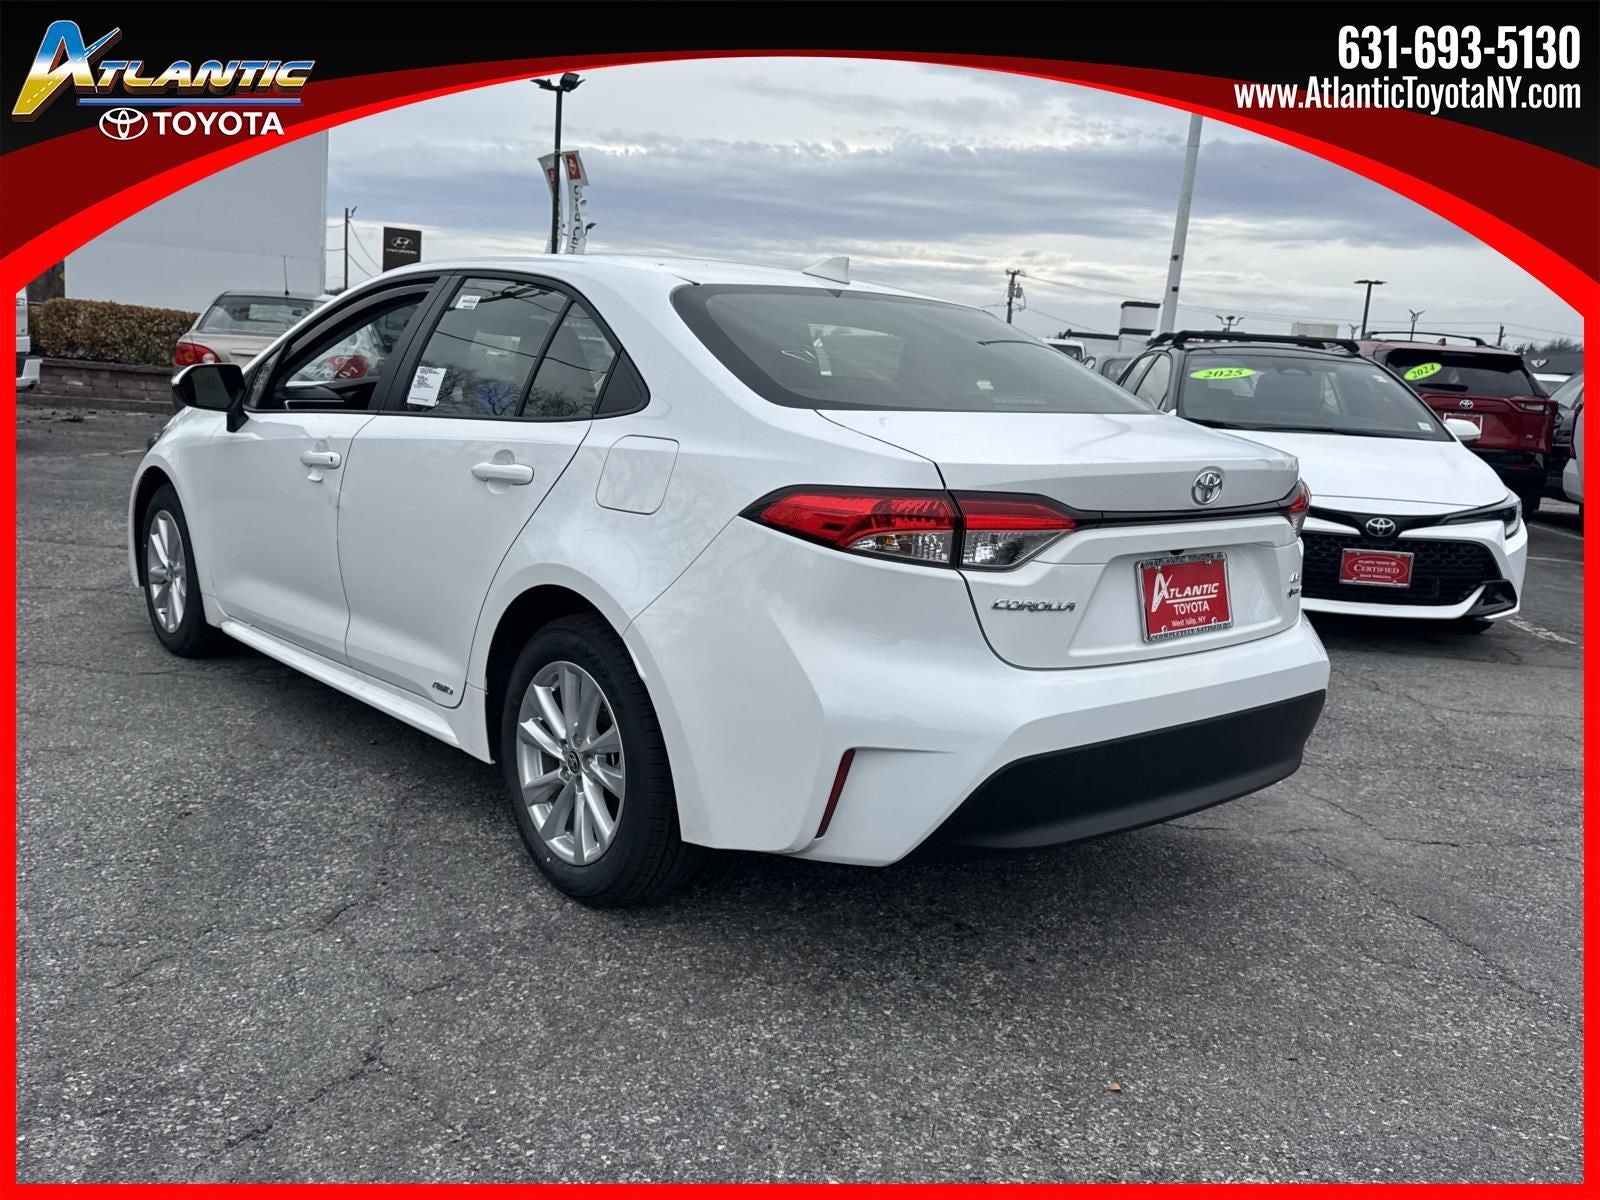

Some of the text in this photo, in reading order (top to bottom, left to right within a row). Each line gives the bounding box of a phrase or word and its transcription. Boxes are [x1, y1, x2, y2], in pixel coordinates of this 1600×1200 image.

[1203, 369, 1243, 378] 2025
[1411, 364, 1436, 379] 2024
[1151, 572, 1220, 612] ATLANTIC
[991, 598, 1077, 612] COROLLA
[1173, 601, 1210, 615] TOYOTA
